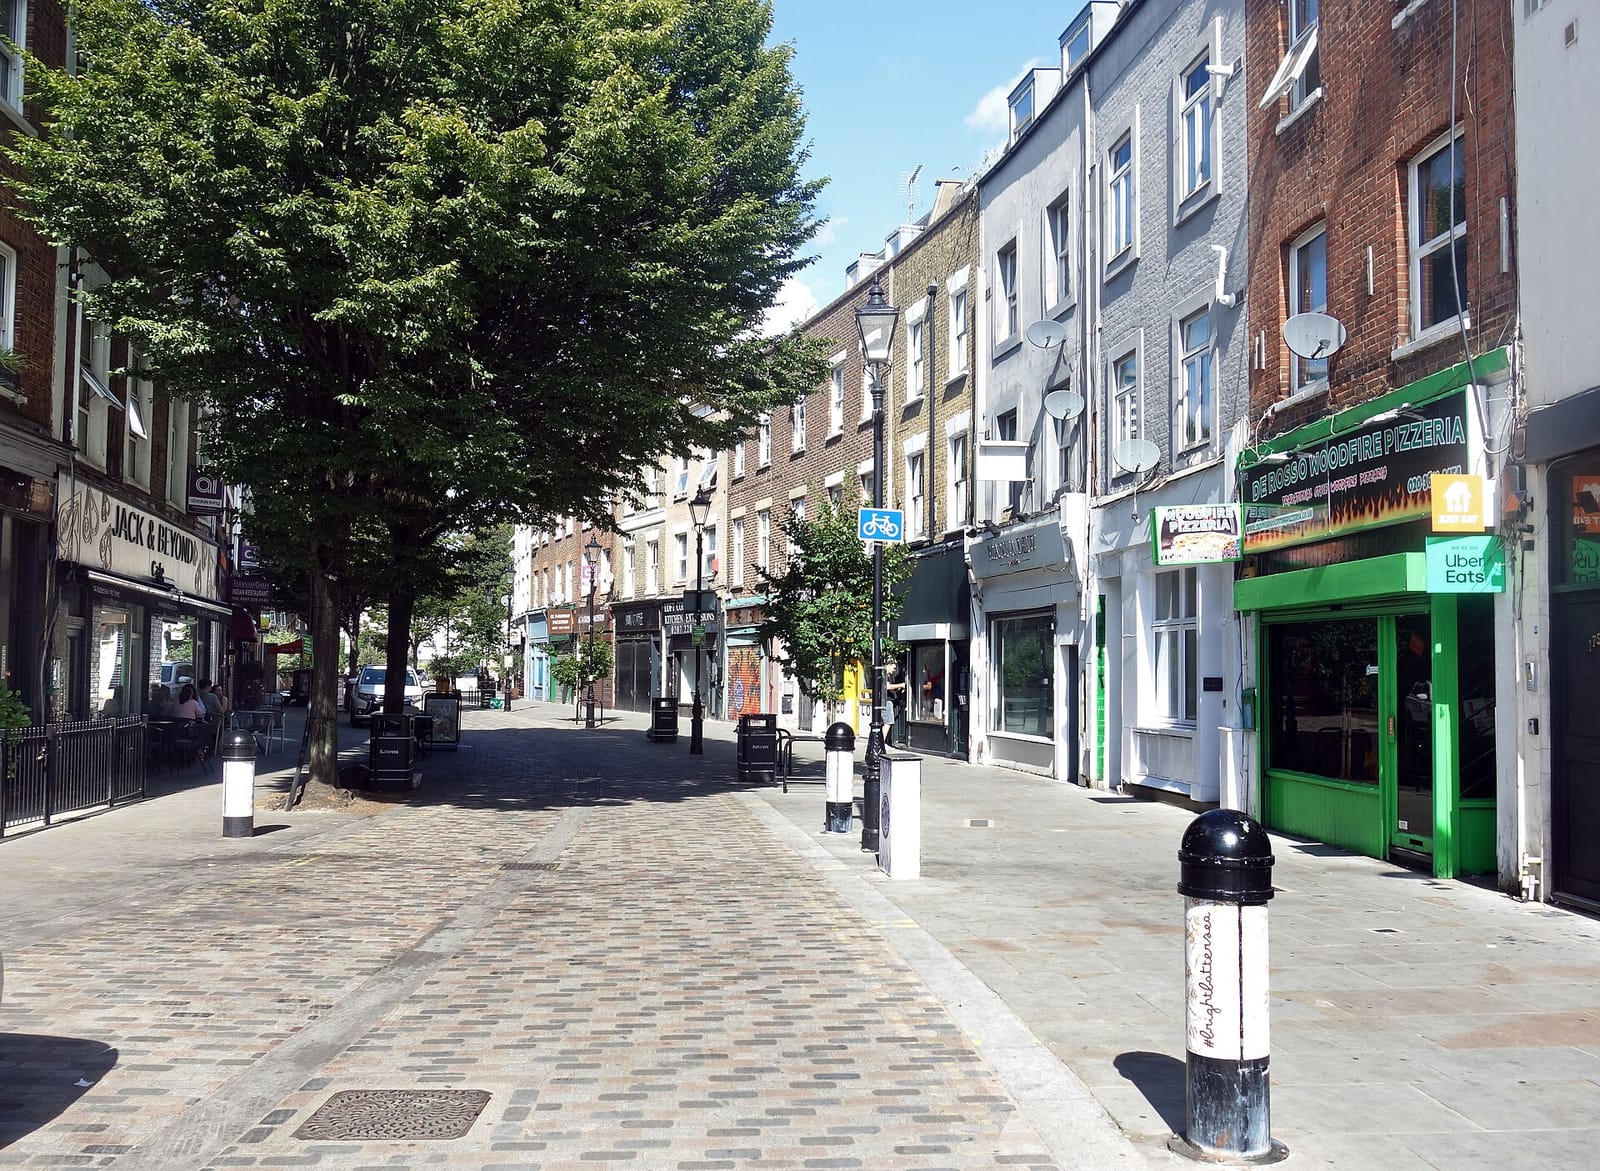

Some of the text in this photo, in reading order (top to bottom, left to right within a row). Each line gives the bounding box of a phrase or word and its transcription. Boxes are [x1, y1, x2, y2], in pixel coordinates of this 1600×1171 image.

[1252, 416, 1465, 502] DE ROSSO WOODFIRE PIZZERIA
[1165, 507, 1233, 521] WOODFIRE
[1438, 514, 1479, 525] JUST EAT
[1169, 519, 1231, 533] PIZZERIA
[112, 505, 193, 564] JACK & BEYOND
[1446, 554, 1484, 567] Uber
[1446, 570, 1484, 583] Eats
[665, 614, 683, 624] KITCHEN
